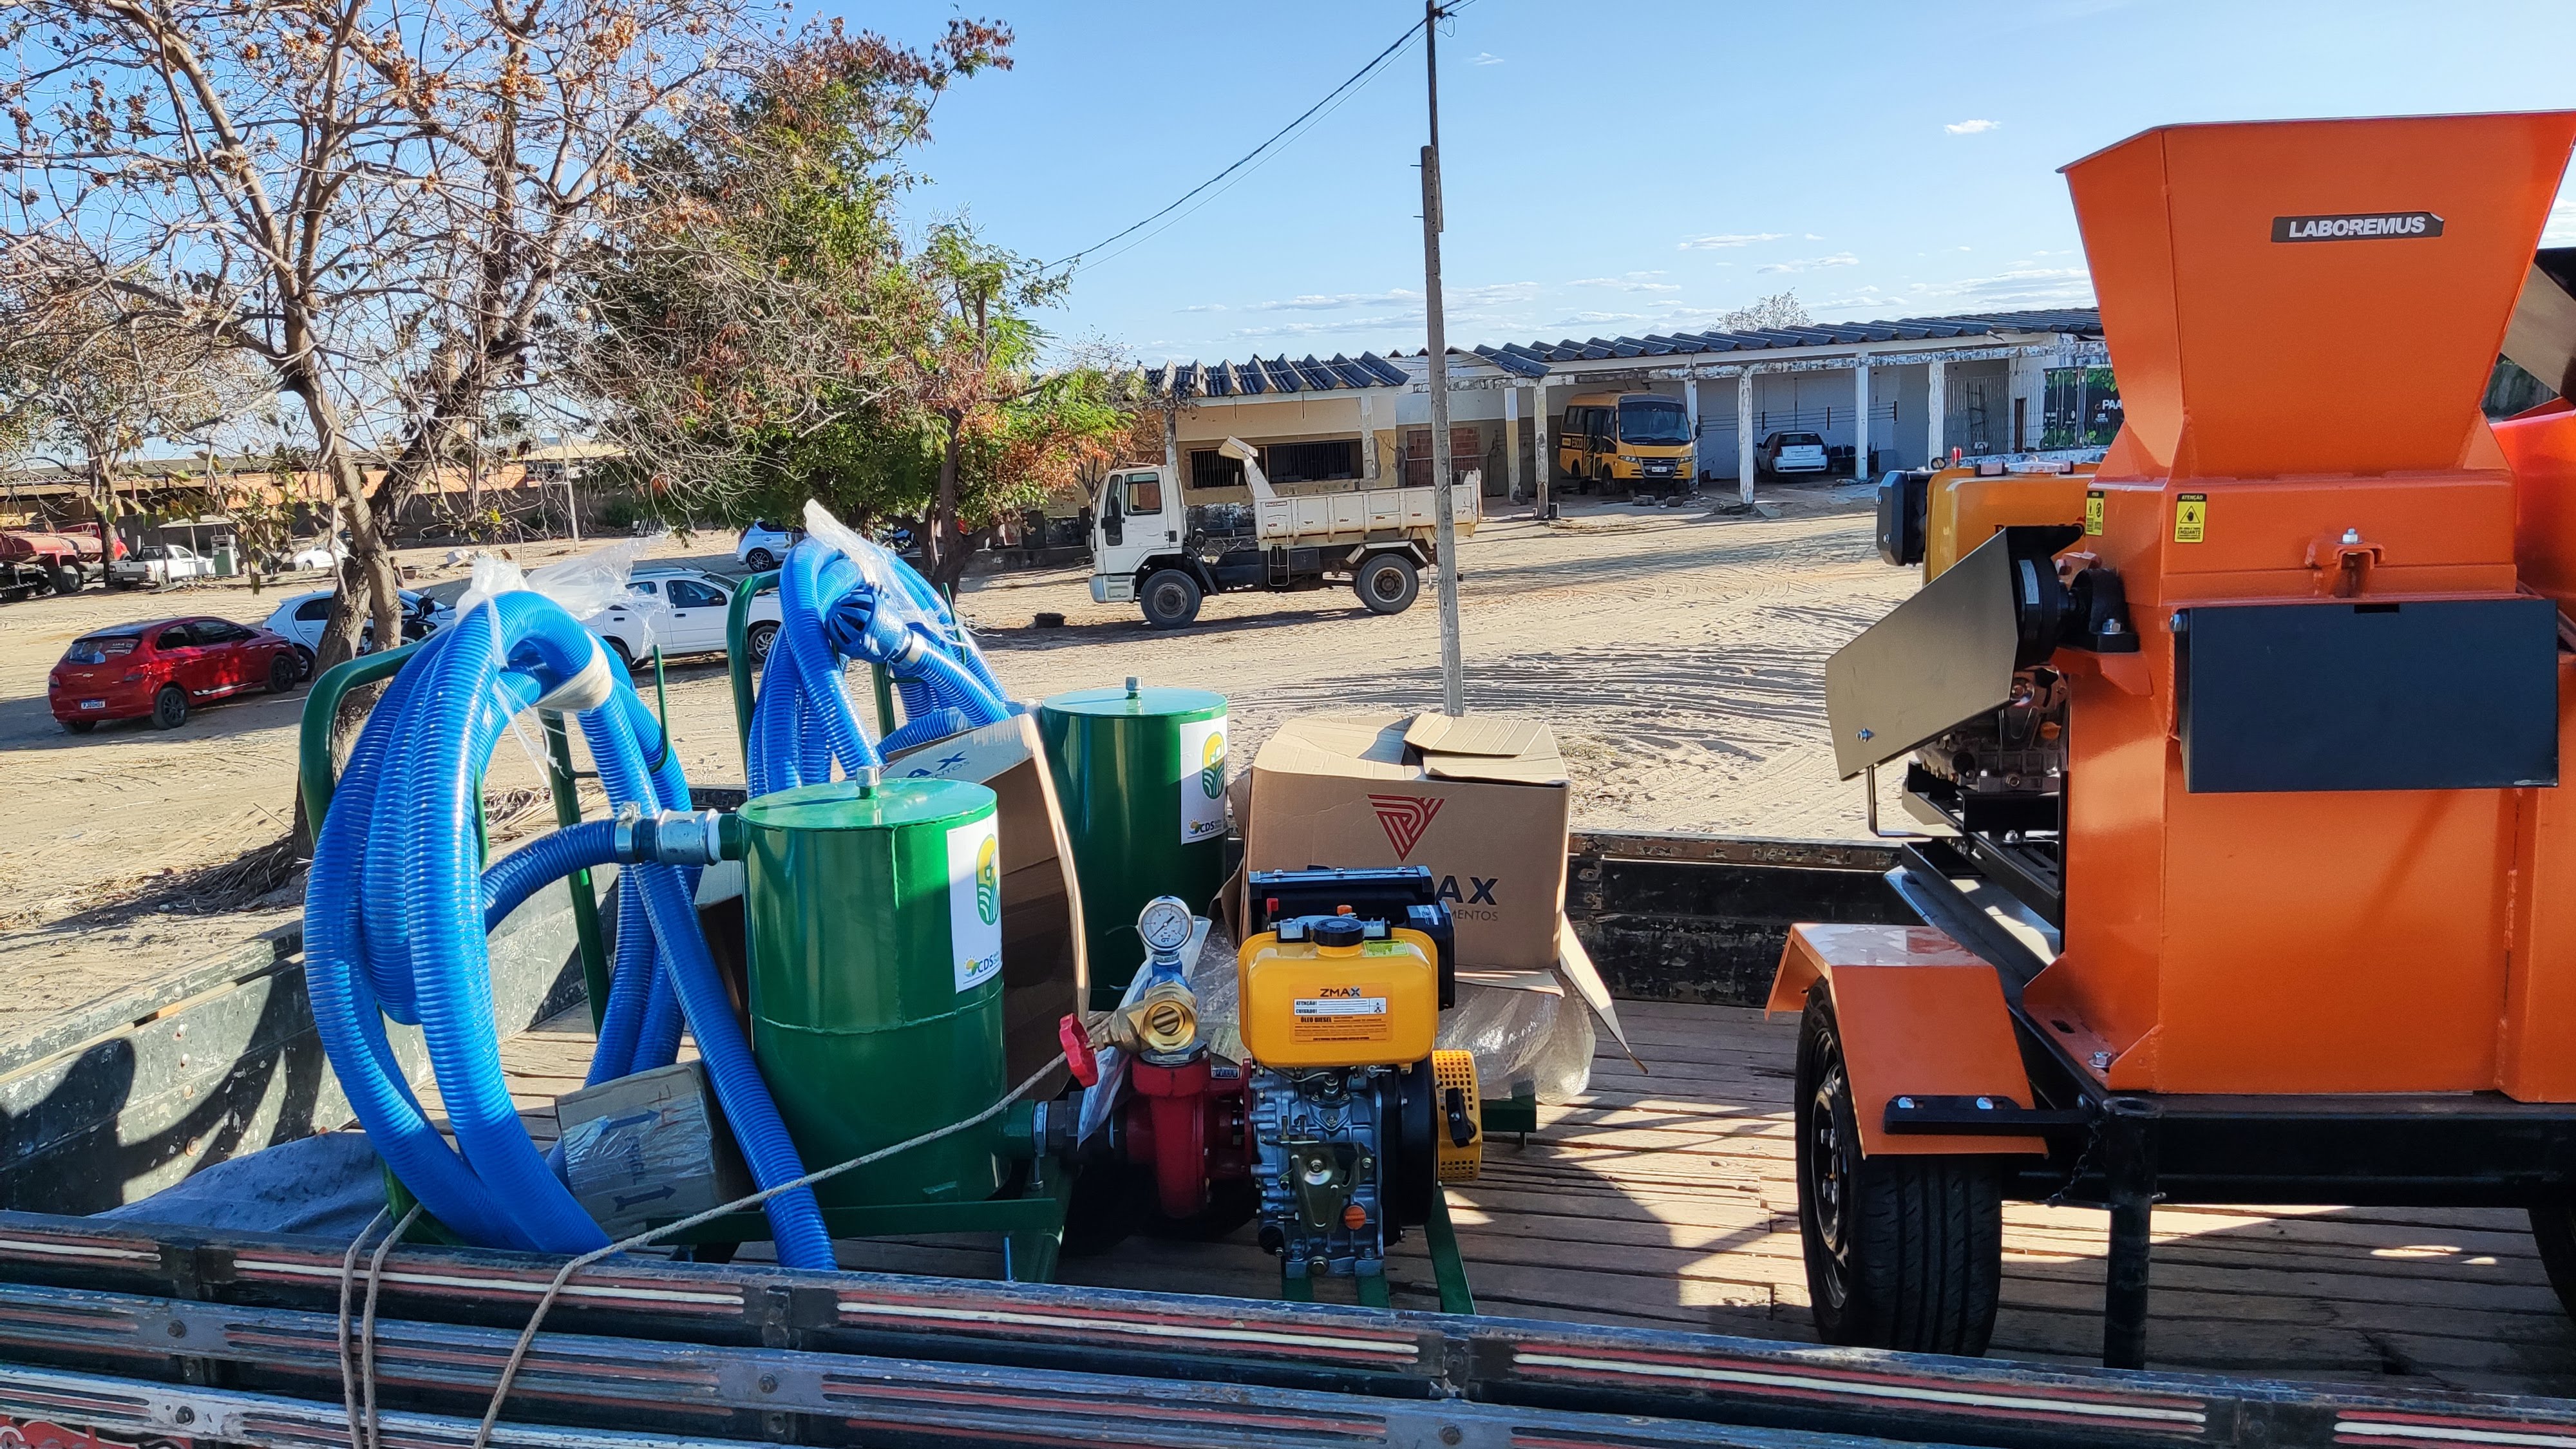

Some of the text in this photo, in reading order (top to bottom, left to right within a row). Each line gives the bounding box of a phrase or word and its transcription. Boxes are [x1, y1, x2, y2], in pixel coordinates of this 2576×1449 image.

[2289, 216, 2425, 238] LABOREMUS
[907, 750, 967, 778] AX
[1200, 820, 1215, 833] CDS
[1435, 875, 1499, 905] AX
[978, 954, 994, 972] CDS
[1320, 988, 1360, 997] ZMAX
